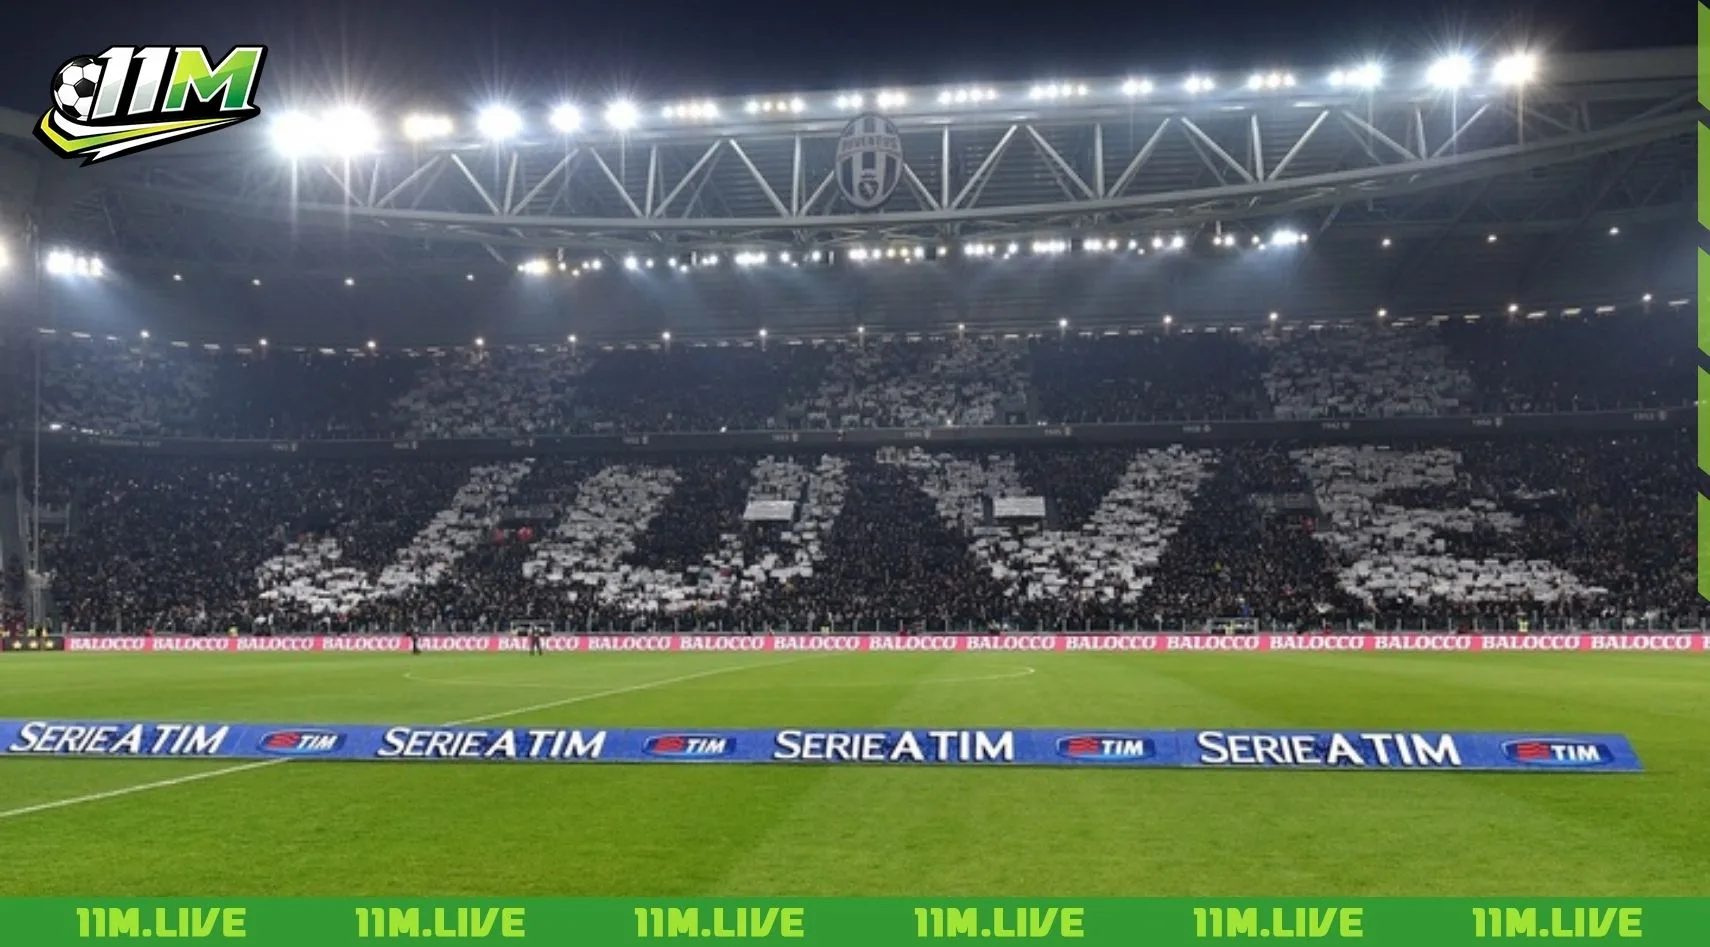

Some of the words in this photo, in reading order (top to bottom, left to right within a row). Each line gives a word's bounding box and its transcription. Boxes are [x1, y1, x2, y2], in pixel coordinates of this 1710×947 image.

[71, 635, 145, 650] BALOCCO
[152, 635, 229, 650] BALOCCO
[236, 635, 314, 650] BALOCCO
[323, 635, 400, 650] BALOCCO
[588, 635, 671, 650] BALOCCO
[680, 635, 764, 650] BALOCCO
[773, 635, 860, 650] BALOCCO
[869, 635, 957, 650] BALOCCO
[966, 635, 1056, 650] BALOCCO
[1066, 635, 1156, 650] BALOCCO
[1167, 635, 1259, 650] BALOCCO
[1270, 635, 1365, 650] BALOCCO
[1374, 635, 1472, 650] BALOCCO
[1481, 635, 1580, 650] BALOCCO
[1591, 635, 1692, 650] BALOCCO
[9, 721, 117, 752] SERIE
[111, 723, 143, 753] A
[151, 724, 229, 754] TIM
[297, 735, 338, 750] TIM
[377, 726, 488, 757] SERIE
[486, 728, 516, 758] A
[528, 730, 607, 758] TIM
[774, 730, 884, 759] SERIE
[890, 730, 923, 760] A
[929, 731, 1014, 760] TIM
[686, 738, 726, 753] TIM
[1100, 740, 1143, 754] TIM
[1197, 731, 1320, 763] SERIE
[1326, 732, 1363, 764] A
[1361, 733, 1461, 765] TIM
[1550, 745, 1600, 760] TIM
